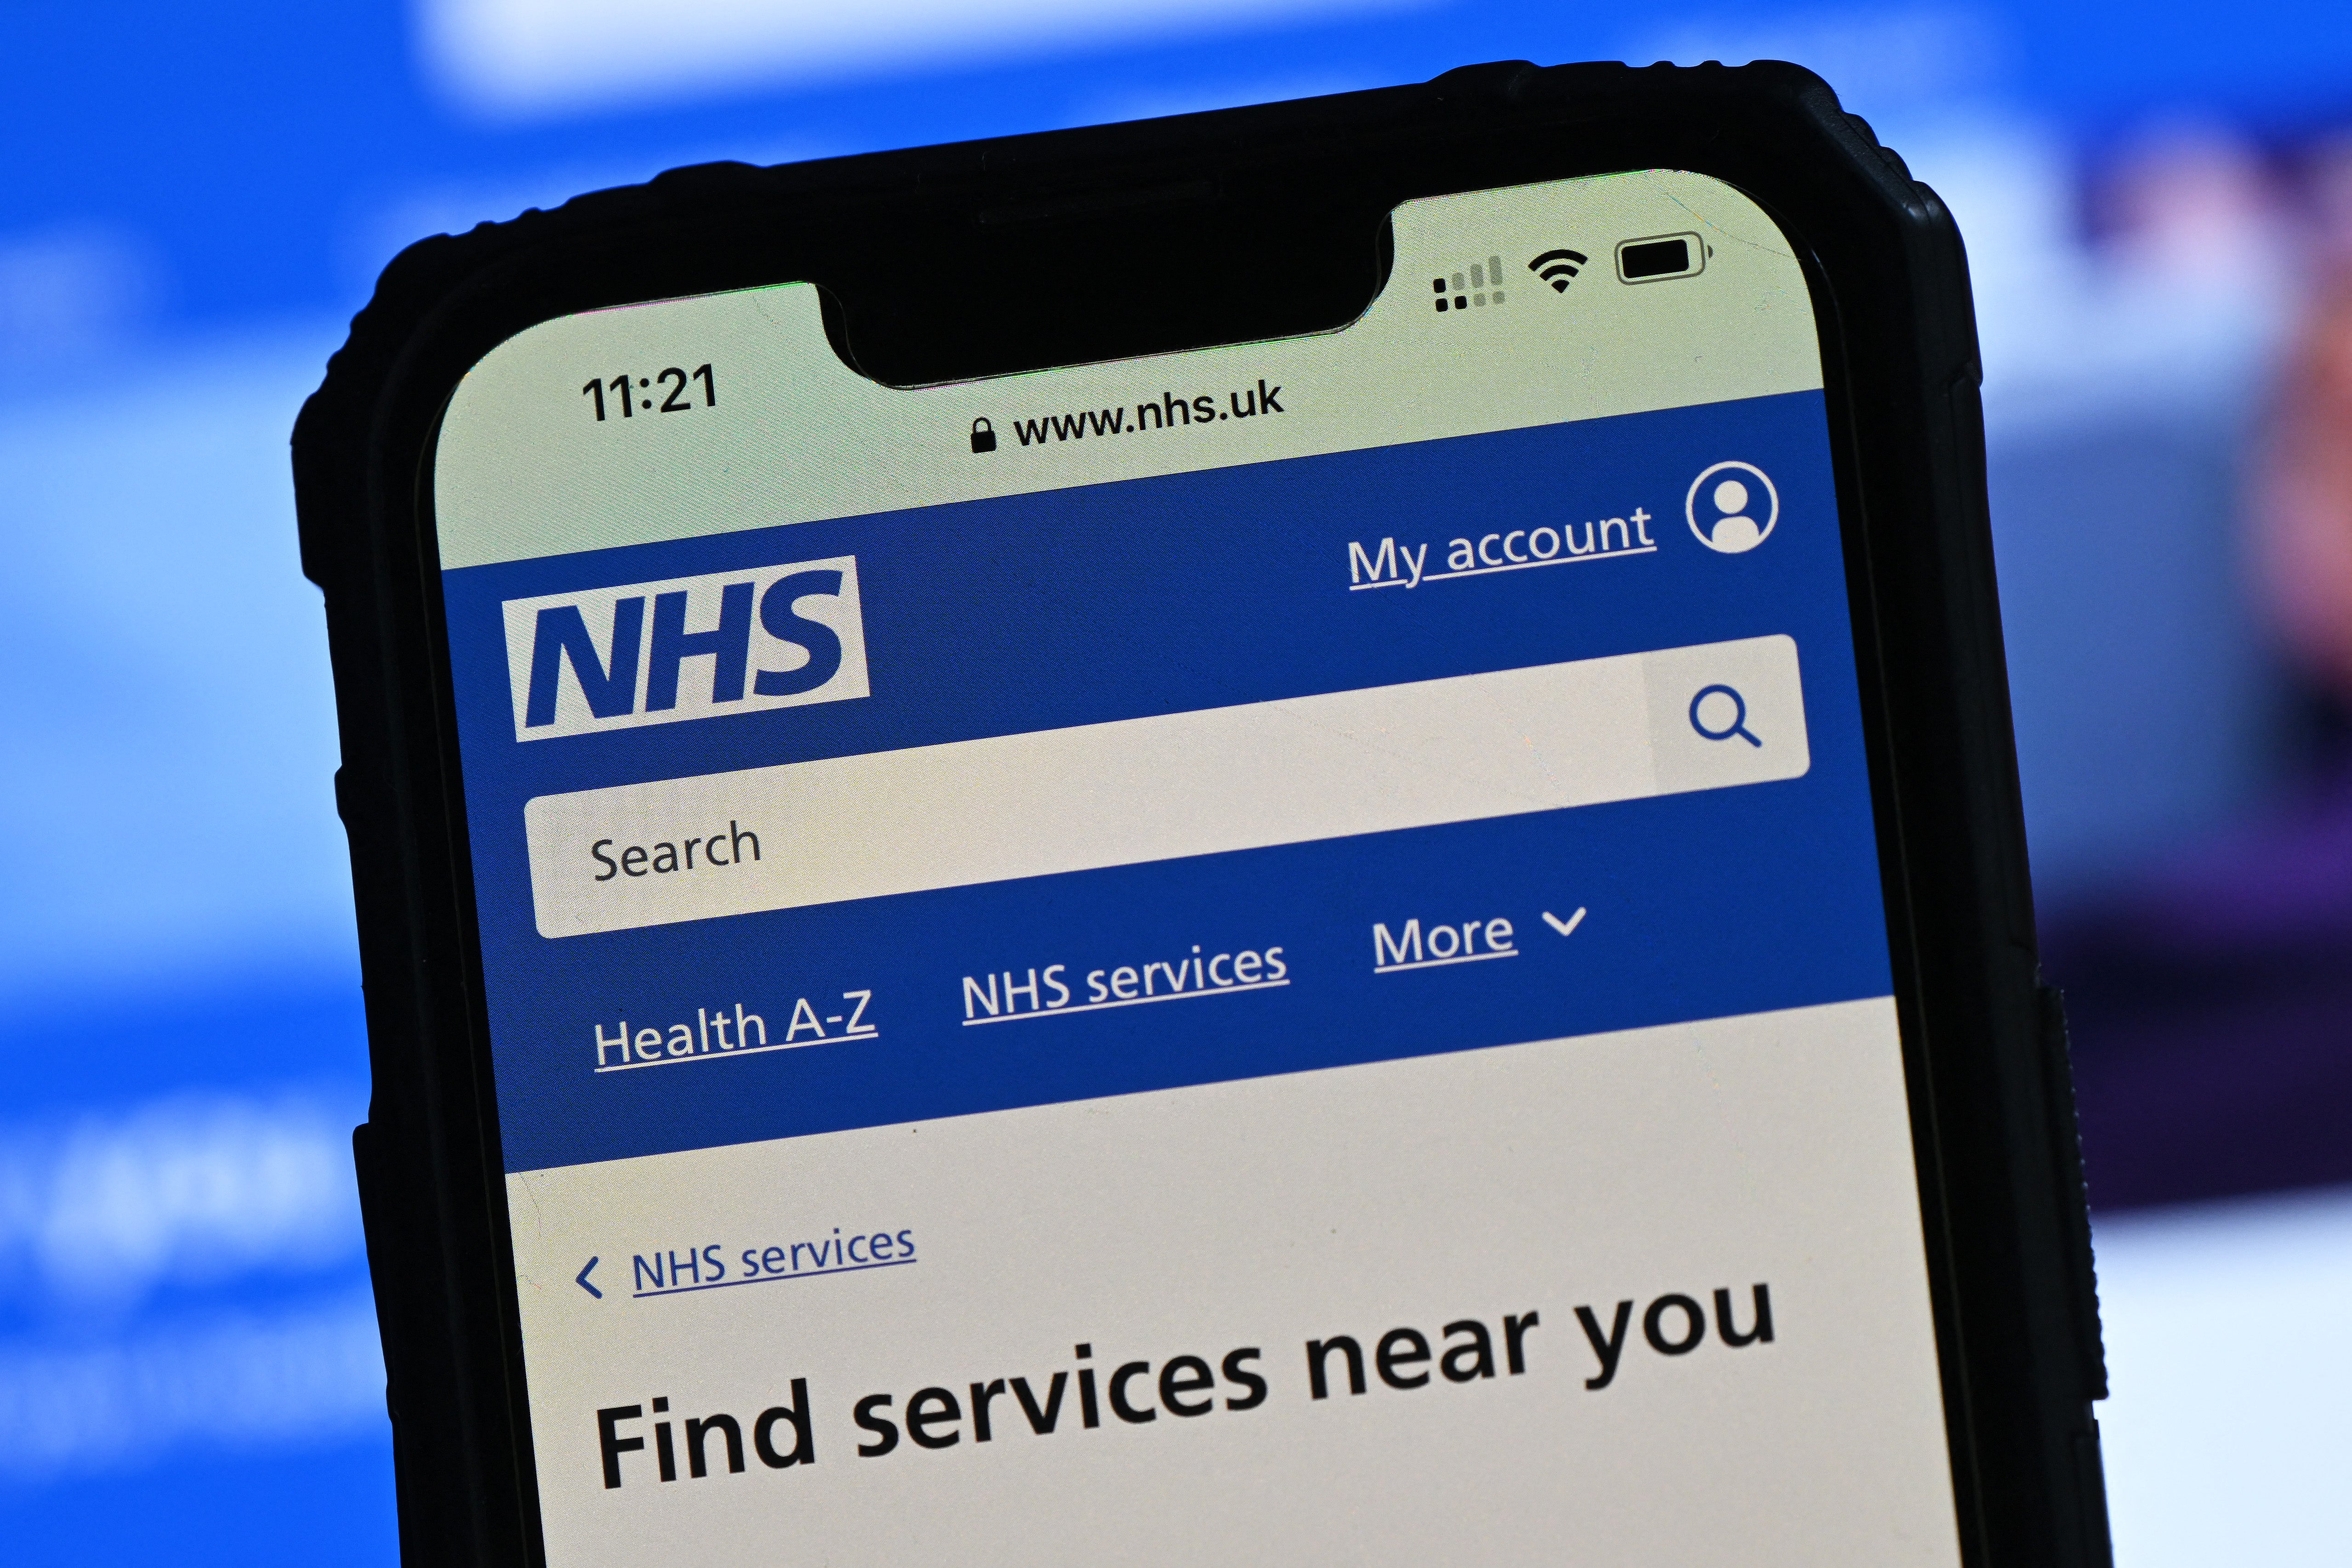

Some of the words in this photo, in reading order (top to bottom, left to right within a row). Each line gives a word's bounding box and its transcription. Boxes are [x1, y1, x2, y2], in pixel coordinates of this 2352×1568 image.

[582, 363, 716, 422] 11:21
[1013, 379, 1284, 447] www.nhs.uk
[1348, 537, 1428, 590] My
[1447, 507, 1655, 571] account
[524, 569, 843, 729] NHS
[591, 820, 761, 882] Search
[1373, 918, 1514, 966] More
[962, 964, 1071, 1019] NHS
[1086, 945, 1287, 1003] services
[594, 1003, 767, 1066] Health
[785, 989, 876, 1042] A-Z
[633, 1244, 726, 1291] NHS
[741, 1227, 916, 1278] services
[597, 1377, 815, 1489] Find
[854, 1343, 1268, 1458] services
[1306, 1311, 1539, 1400] near
[1574, 1283, 1774, 1391] you
